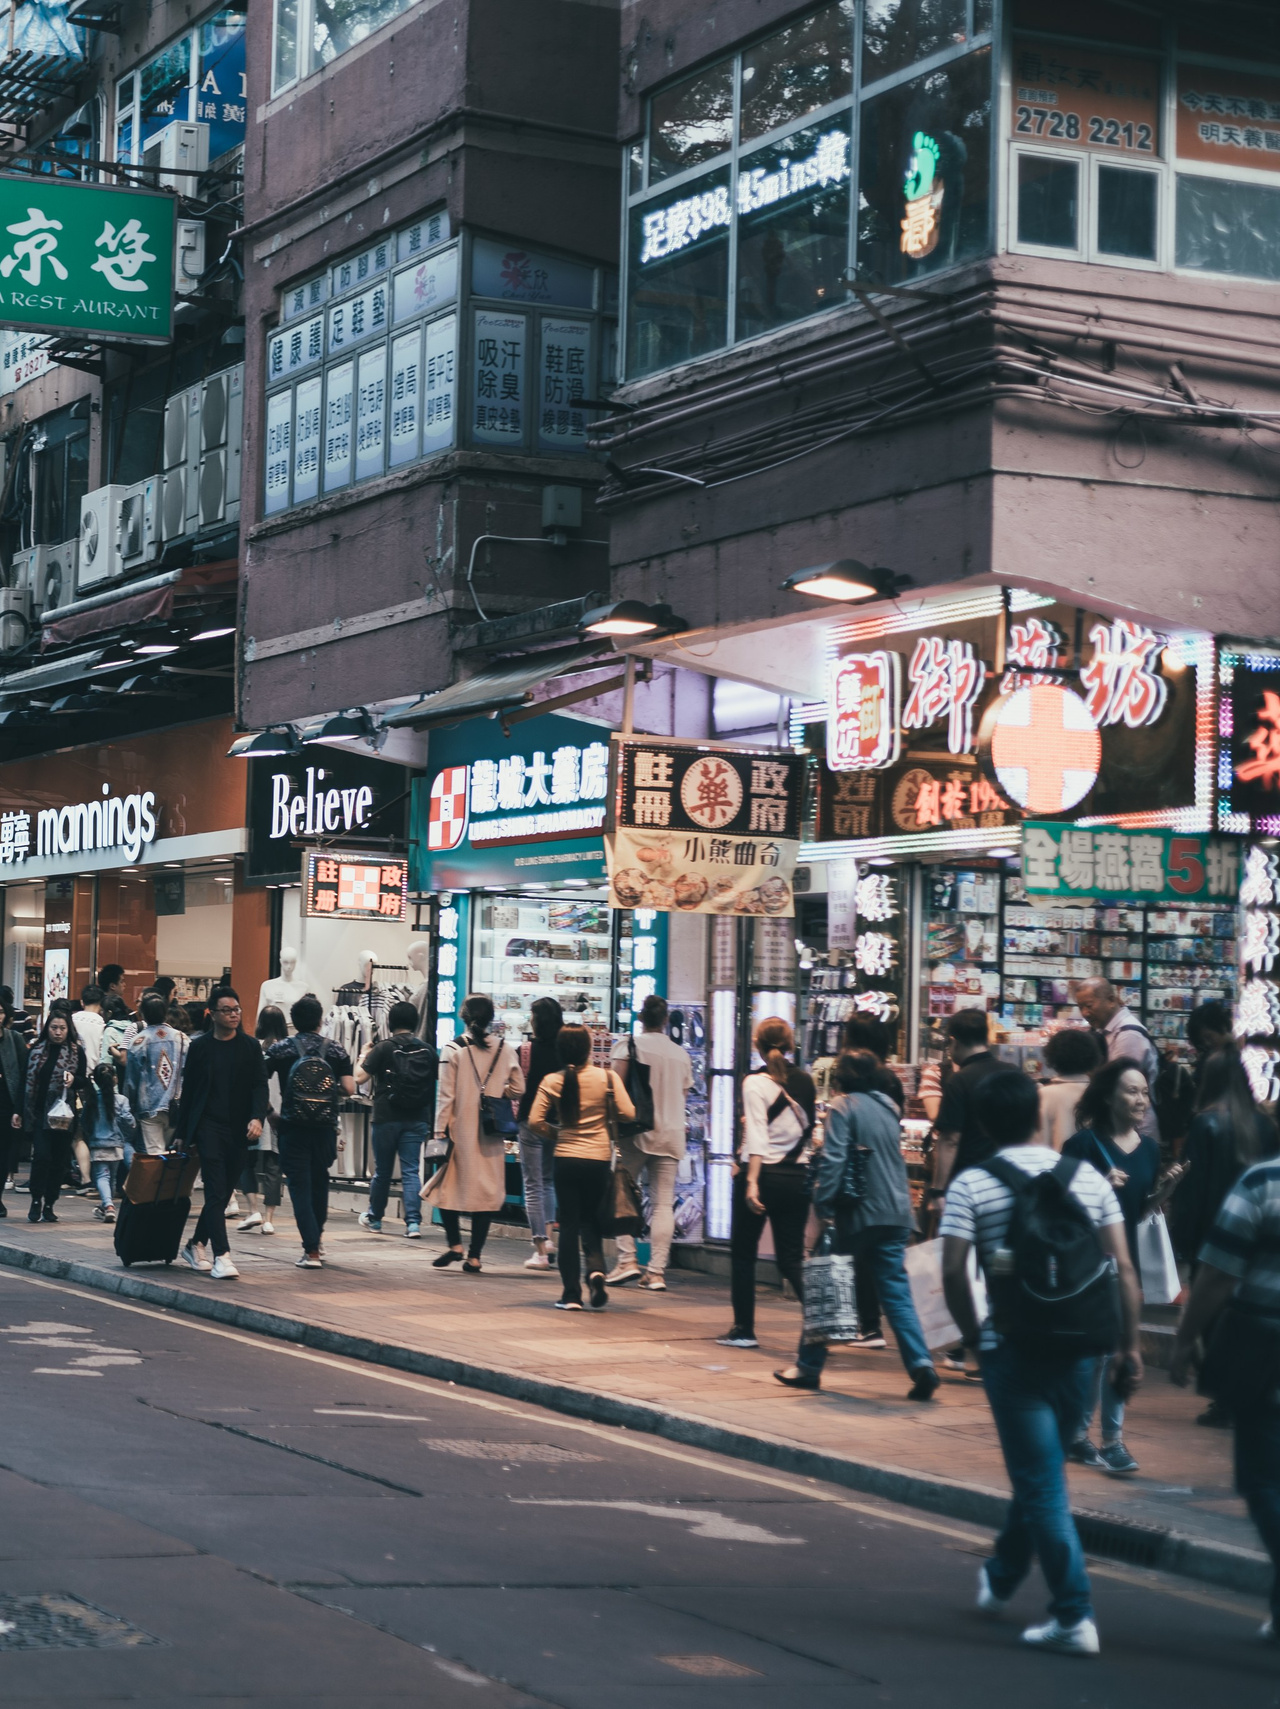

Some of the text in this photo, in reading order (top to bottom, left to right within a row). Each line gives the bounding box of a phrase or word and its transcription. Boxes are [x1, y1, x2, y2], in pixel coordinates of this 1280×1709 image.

[1017, 107, 1152, 151] 2728 2212
[477, 338, 522, 370] 吸汗
[545, 344, 585, 375] 鞋底
[477, 369, 521, 402] 除臭
[545, 375, 585, 404] 防滑
[270, 766, 373, 839] Believe
[749, 760, 790, 833] 政府
[0, 809, 31, 864] 萬寧
[37, 782, 156, 862] mannings
[537, 805, 607, 834] PHARMACY
[683, 836, 784, 868] 小熊曲奇
[1024, 828, 1239, 898] 全場燕窩5折
[379, 865, 403, 916] 政府
